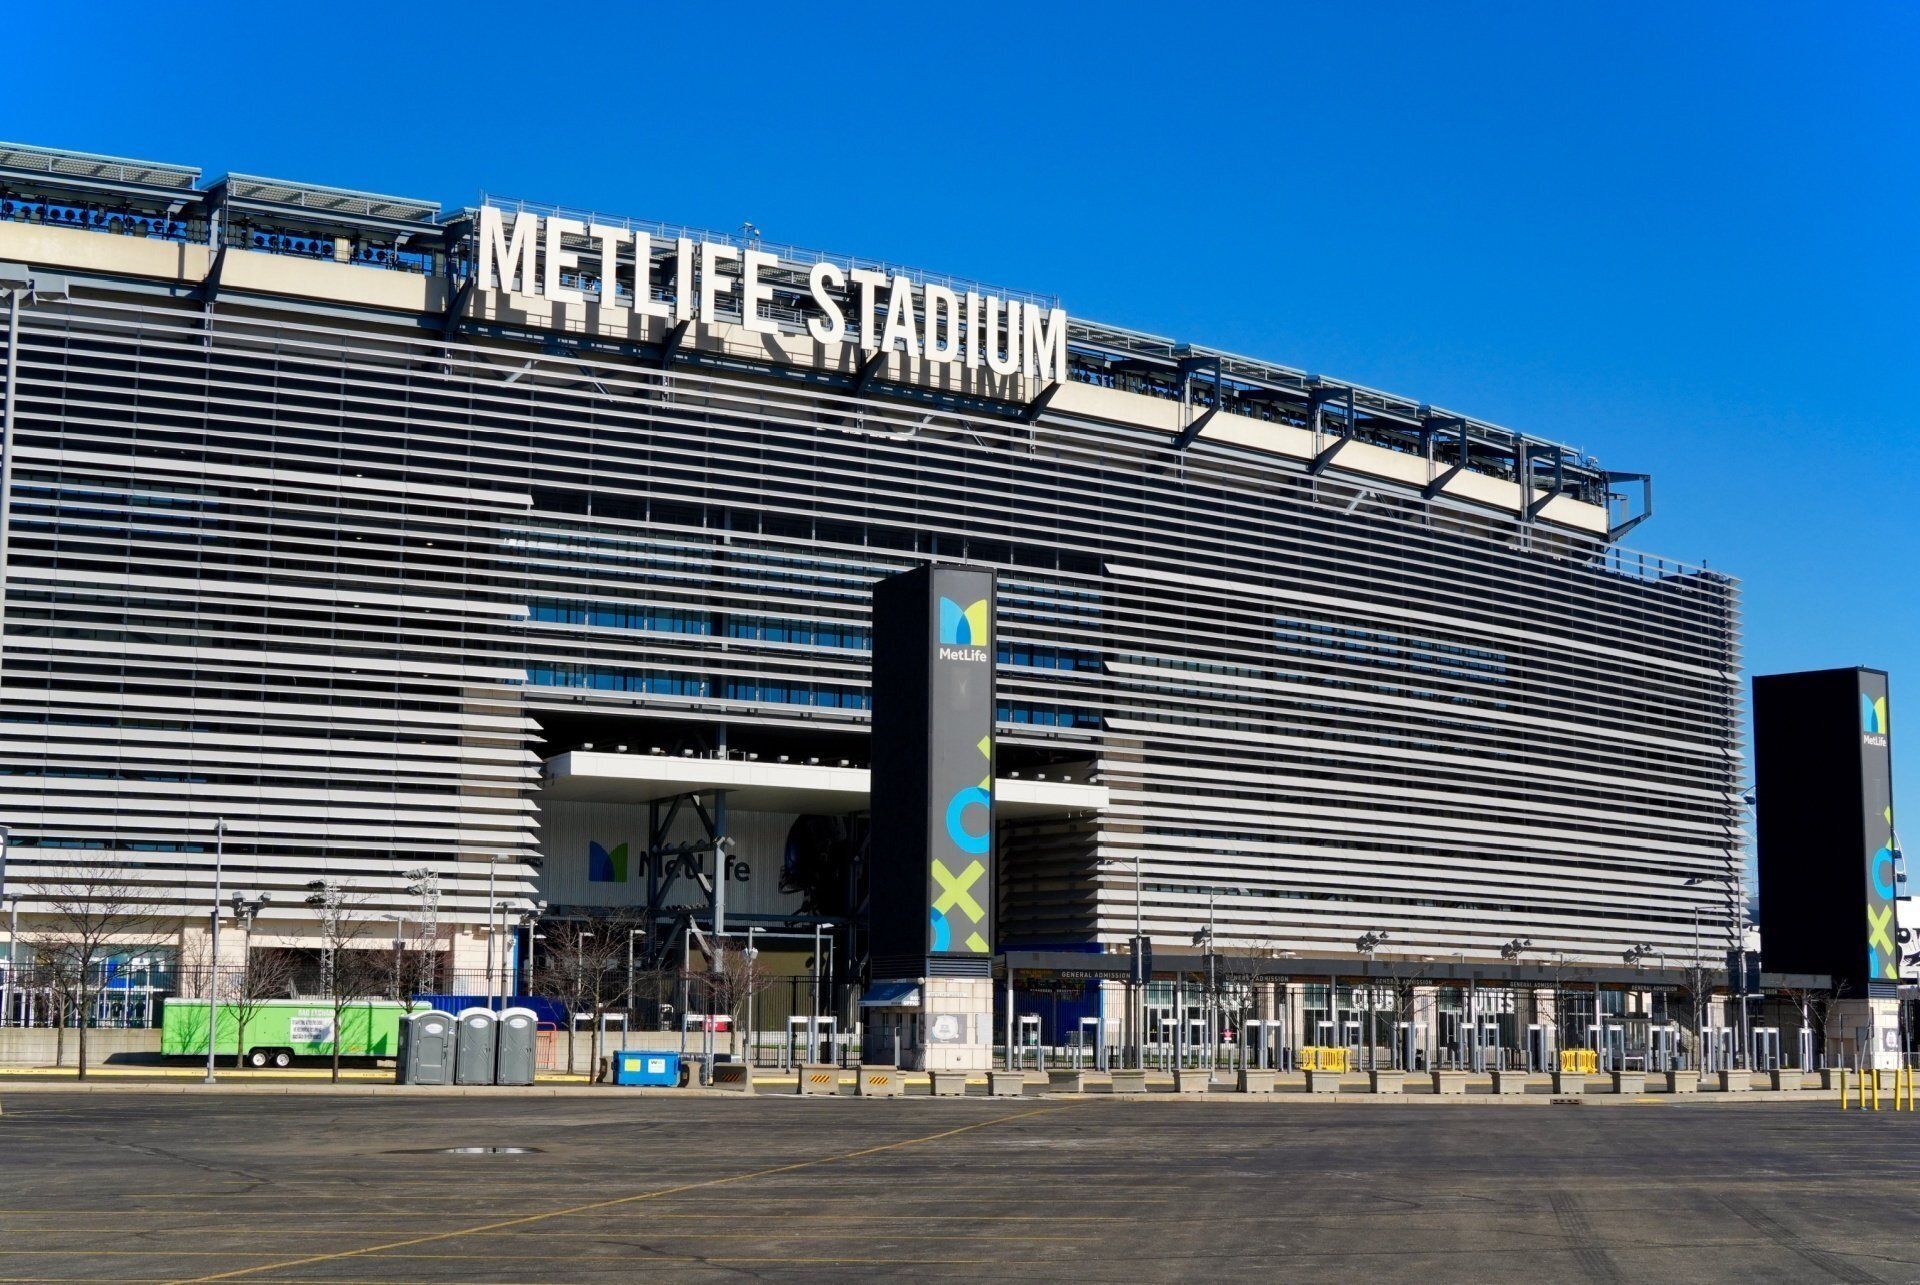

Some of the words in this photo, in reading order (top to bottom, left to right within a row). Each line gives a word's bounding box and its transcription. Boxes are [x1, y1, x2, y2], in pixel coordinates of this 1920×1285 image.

[477, 204, 780, 335] METLIFE
[806, 262, 1067, 386] STADIUM
[939, 647, 987, 662] MetLife
[1863, 734, 1887, 747] MetLife
[1094, 971, 1131, 979] ADMISSION
